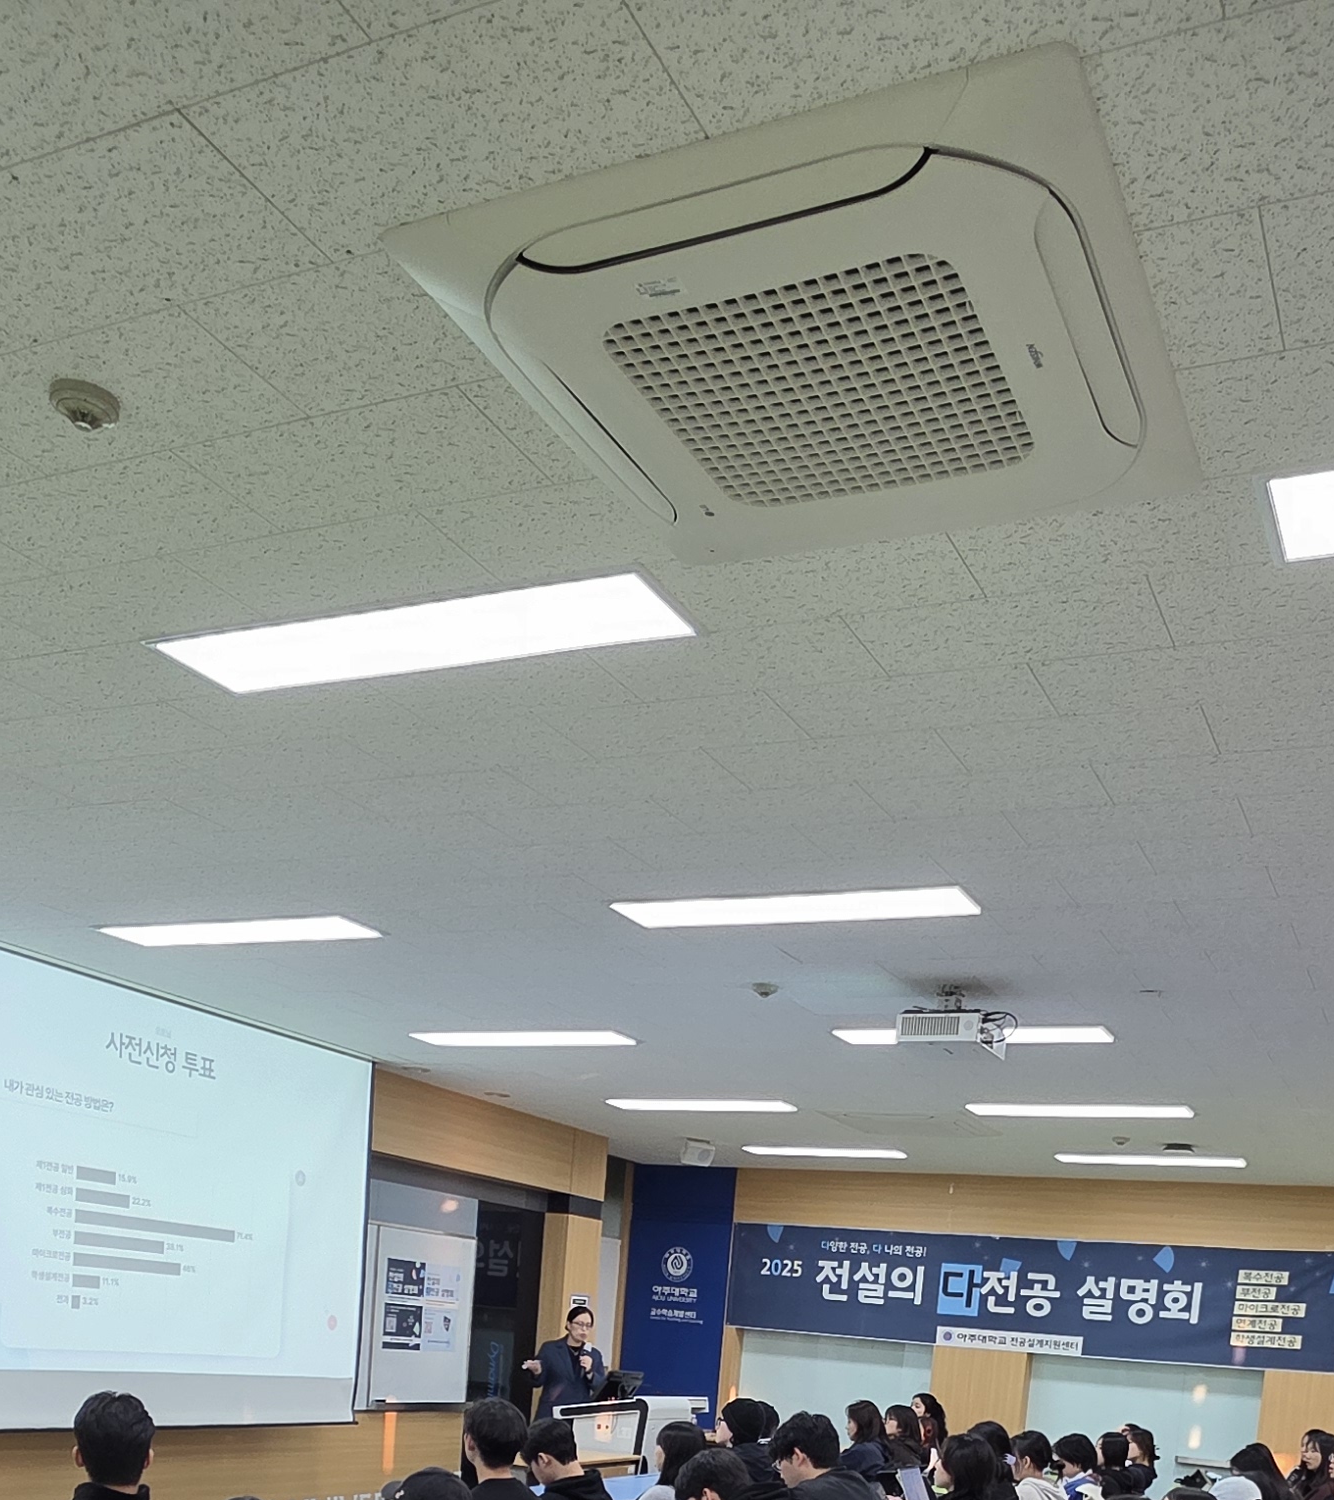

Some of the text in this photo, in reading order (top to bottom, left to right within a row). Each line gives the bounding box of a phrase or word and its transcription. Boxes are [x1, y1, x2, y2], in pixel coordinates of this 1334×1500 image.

[105, 1031, 216, 1080] 사전신청 투표
[4, 1078, 23, 1095] 내가
[25, 1083, 44, 1098] 관심
[45, 1088, 64, 1102] 있는
[64, 1091, 82, 1107] 전공
[821, 1240, 927, 1258] 다양한 전공, 다 나의 전공!
[1243, 1271, 1284, 1283] 복수전공
[760, 1258, 1203, 1325] 2025 전설의 다전공 설명회
[1240, 1287, 1271, 1298] 부전공
[1238, 1303, 1301, 1315] 마이크로전공
[1236, 1319, 1277, 1331] 연계전공
[956, 1332, 1079, 1351] 아주대학교 전공설계지원센터
[1236, 1335, 1296, 1347] 학생설계전공
